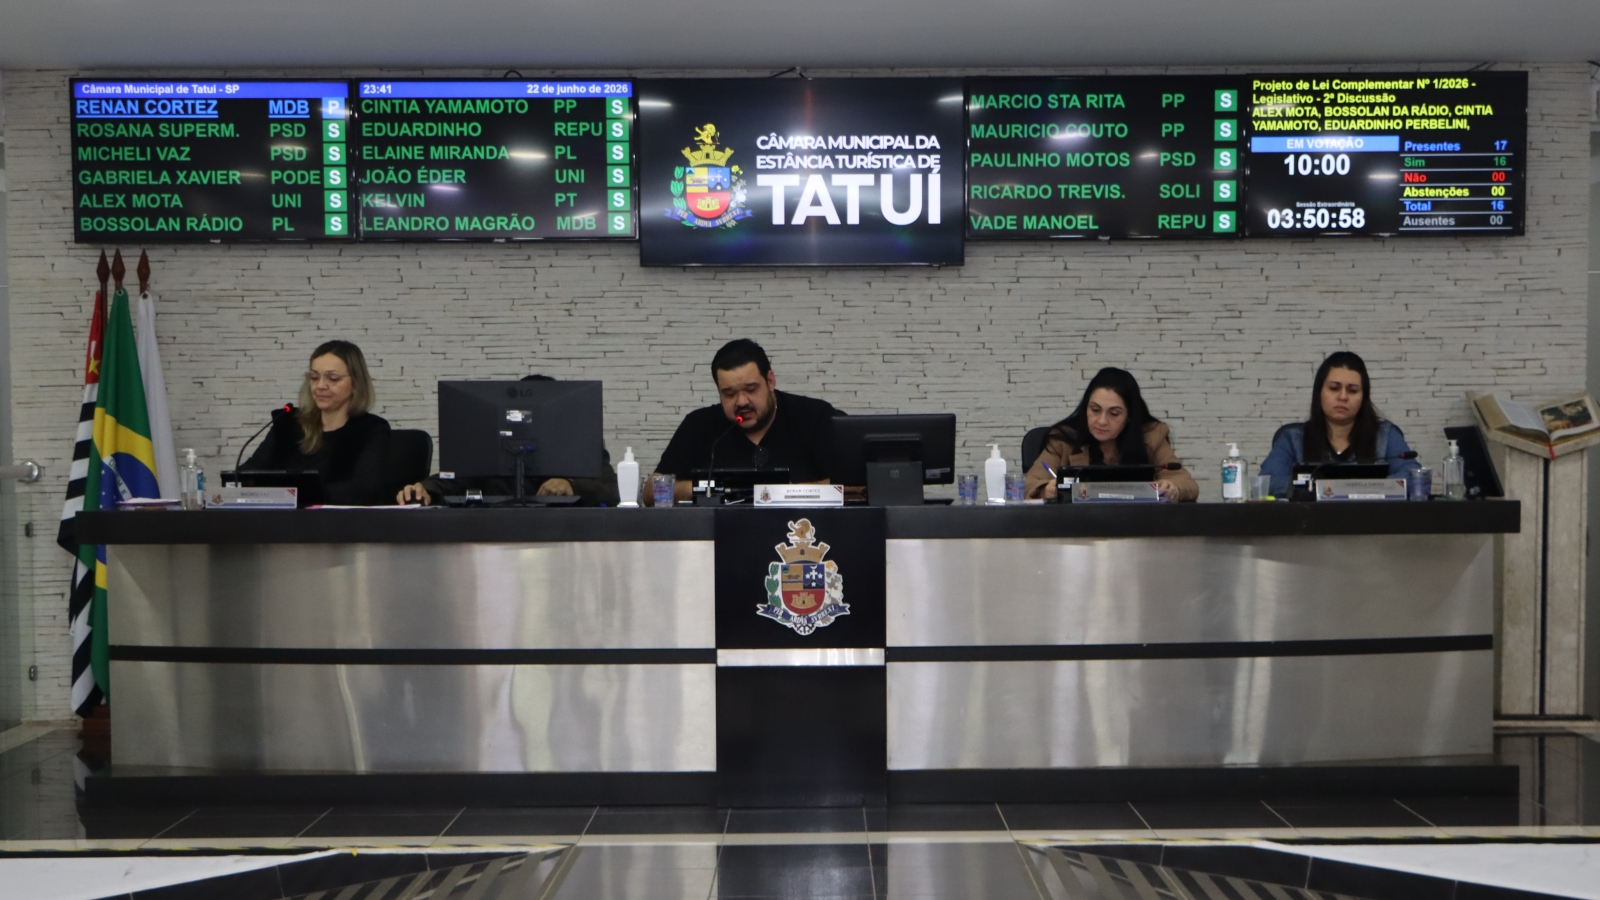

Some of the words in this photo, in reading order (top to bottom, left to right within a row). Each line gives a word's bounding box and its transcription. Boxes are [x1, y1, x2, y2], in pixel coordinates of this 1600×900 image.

[82, 84, 121, 94] Câmara
[124, 85, 173, 95] Municipal
[176, 85, 188, 94] de
[225, 85, 239, 94] SP
[364, 85, 392, 94] 23:41
[527, 84, 539, 93] 22
[542, 84, 554, 93] de
[556, 84, 586, 95] junho
[589, 84, 601, 93] de
[604, 84, 628, 93] 2026
[1253, 81, 1294, 92] Projeto
[1296, 80, 1309, 90] de
[1312, 80, 1329, 90] Lei
[1332, 79, 1413, 92] Complementar
[1433, 79, 1468, 89] 1/2026
[971, 95, 1042, 109] MARCIO
[1048, 94, 1081, 108] STA
[1086, 94, 1125, 108] RITA
[1162, 94, 1185, 107] PP
[1220, 93, 1232, 107] S
[1253, 94, 1313, 105] Legislativo
[1337, 93, 1396, 103] Discussão
[76, 100, 139, 114] RENAN
[145, 100, 218, 114] CORTEZ
[269, 100, 309, 114] MDB
[328, 101, 339, 114] P
[361, 100, 420, 113] CINTIA
[425, 100, 528, 113] YAMAMOTO
[554, 100, 577, 113] PP
[611, 100, 623, 114] S
[1253, 108, 1283, 117] ALEX
[1286, 107, 1321, 119] MOTA,
[1325, 106, 1390, 116] BOSSOLAN
[1392, 106, 1409, 115] DA
[1411, 104, 1452, 117] RÁDIO,
[1455, 105, 1493, 115] CINTIA
[77, 123, 153, 137] ROSANA
[159, 123, 239, 137] SUPERM.
[270, 124, 306, 137] PSD
[328, 124, 340, 138] S
[362, 122, 481, 137] EDUARDINHO
[554, 123, 602, 136] REPU
[612, 123, 623, 137] S
[971, 124, 1059, 138] MAURICIO
[1065, 123, 1128, 138] COUTO
[1162, 124, 1184, 137] PP
[1220, 123, 1231, 137] S
[1253, 121, 1321, 132] YAMAMOTO,
[1325, 120, 1403, 130] EDUARDINHO
[1406, 119, 1470, 130] PERBELINI,
[757, 132, 826, 150] CÂMARA
[828, 136, 914, 149] MUNICIPAL
[916, 136, 940, 149] DA
[1287, 140, 1304, 148] EM
[1307, 138, 1363, 149] VOTAÇÃO
[1404, 142, 1460, 151] Presentes
[1494, 141, 1507, 150] 17
[78, 147, 151, 160] MICHELI
[156, 147, 191, 160] VAZ
[270, 147, 307, 160] PSD
[328, 147, 340, 161] S
[362, 146, 424, 160] ELAINE
[430, 146, 509, 160] MIRANDA
[555, 146, 577, 159] PL
[612, 146, 624, 160] S
[971, 153, 1060, 167] PAULINHO
[1066, 153, 1130, 167] MOTOS
[1160, 153, 1196, 166] PSD
[1219, 152, 1231, 166] S
[756, 152, 833, 169] ESTÂNCIA
[835, 152, 920, 169] TURÍSTICA
[922, 155, 940, 168] DE
[1284, 154, 1350, 175] 10:00
[1404, 158, 1425, 166] Sim
[1493, 157, 1506, 166] 16
[79, 171, 171, 184] GABRIELA
[176, 171, 241, 184] XAVIER
[271, 171, 321, 184] PODE
[329, 171, 341, 184] S
[362, 166, 411, 184] JOÃO
[418, 166, 466, 184] ÉDER
[555, 170, 584, 183] UNI
[613, 169, 624, 183] S
[1404, 173, 1426, 182] Não
[1492, 172, 1505, 181] 00
[757, 166, 941, 225] TATUÍ
[971, 185, 1052, 199] RICARDO
[1058, 184, 1125, 198] TREVIS.
[1160, 184, 1200, 198] SOLI
[1219, 184, 1231, 198] S
[1404, 187, 1469, 198] Abstenções
[1491, 186, 1505, 196] 00
[79, 194, 127, 208] ALEX
[132, 194, 183, 208] MOTA
[272, 194, 301, 208] UNI
[330, 194, 342, 208] S
[362, 193, 425, 207] KELVIN
[555, 193, 577, 207] PT
[613, 193, 625, 207] S
[1404, 201, 1431, 211] Total
[1491, 201, 1504, 210] 16
[80, 217, 180, 231] BOSSOLAN
[187, 214, 243, 231] RÁDIO
[273, 217, 294, 231] PL
[331, 217, 342, 231] S
[362, 216, 449, 231] LEANDRO
[455, 213, 535, 231] MAGRÃO
[557, 217, 596, 230] MDB
[614, 216, 625, 230] S
[970, 216, 1017, 229] VADE
[1023, 216, 1098, 229] MANOEL
[1158, 215, 1206, 229] REPU
[1219, 214, 1230, 228] S
[1267, 209, 1365, 228] 03:50:58
[1403, 216, 1455, 225] Ausentes
[1490, 215, 1503, 225] 00
[520, 389, 532, 397] LG
[773, 607, 784, 616] PER
